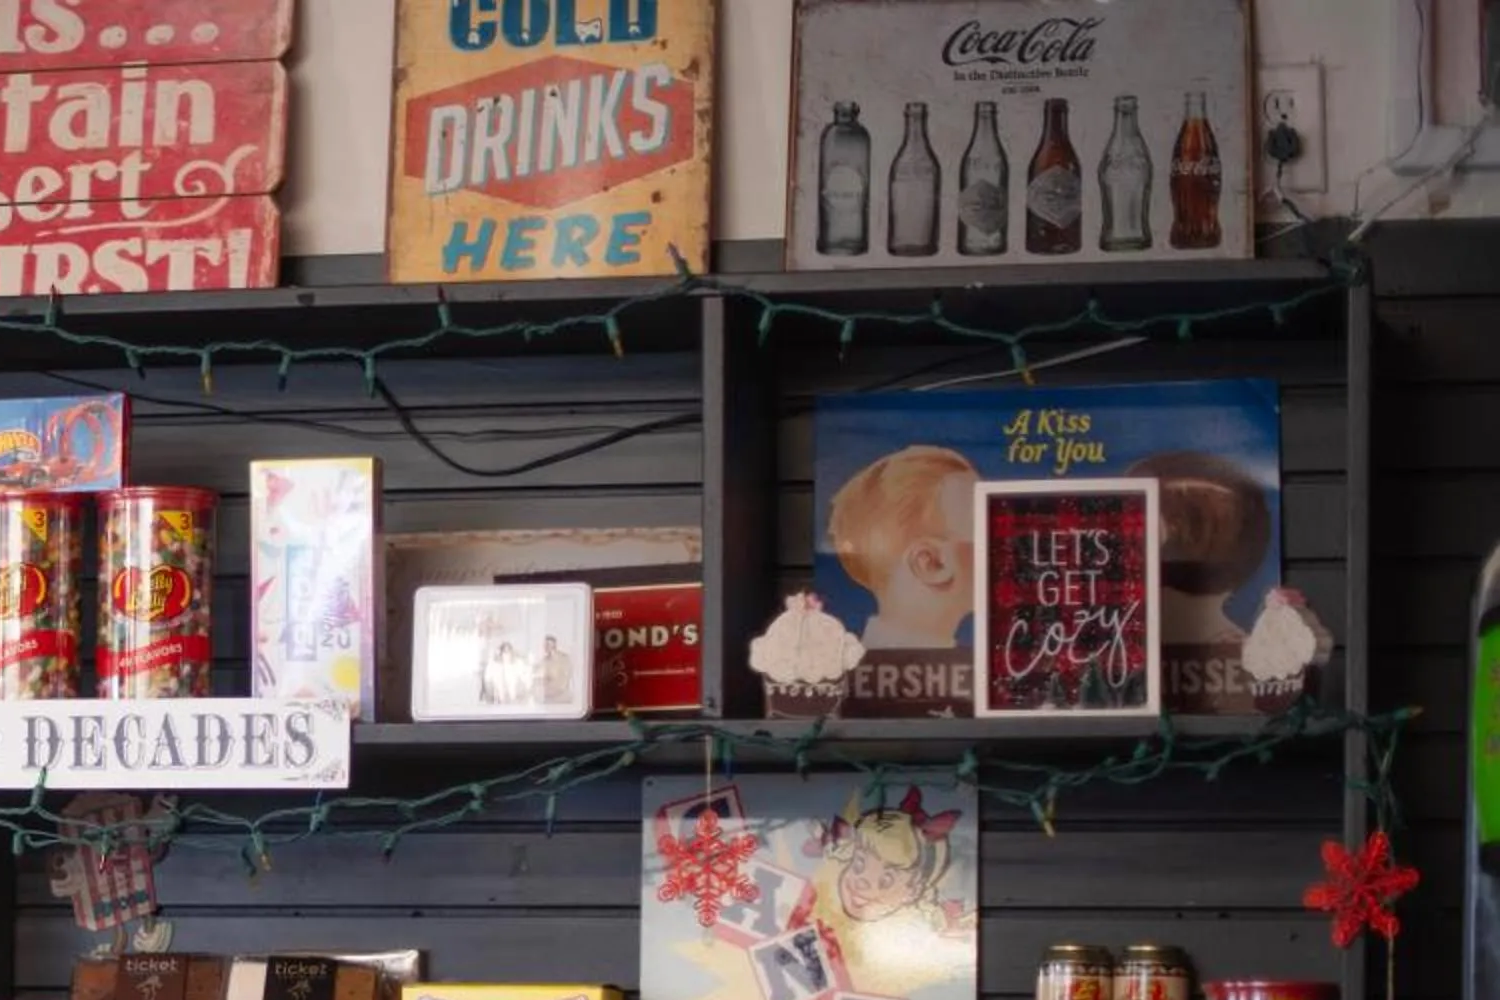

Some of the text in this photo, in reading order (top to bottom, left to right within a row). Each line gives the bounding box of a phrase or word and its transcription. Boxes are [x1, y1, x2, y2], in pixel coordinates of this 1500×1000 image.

[425, 63, 673, 195] DRINKS
[441, 212, 653, 274] HERE
[1003, 407, 1091, 437] A Kiss
[1007, 436, 1106, 475] for You
[1032, 529, 1111, 568] LET'S
[1036, 569, 1101, 609] GET
[25, 712, 318, 772] DECADES
[126, 958, 179, 973] ticket
[274, 961, 328, 976] ticket
